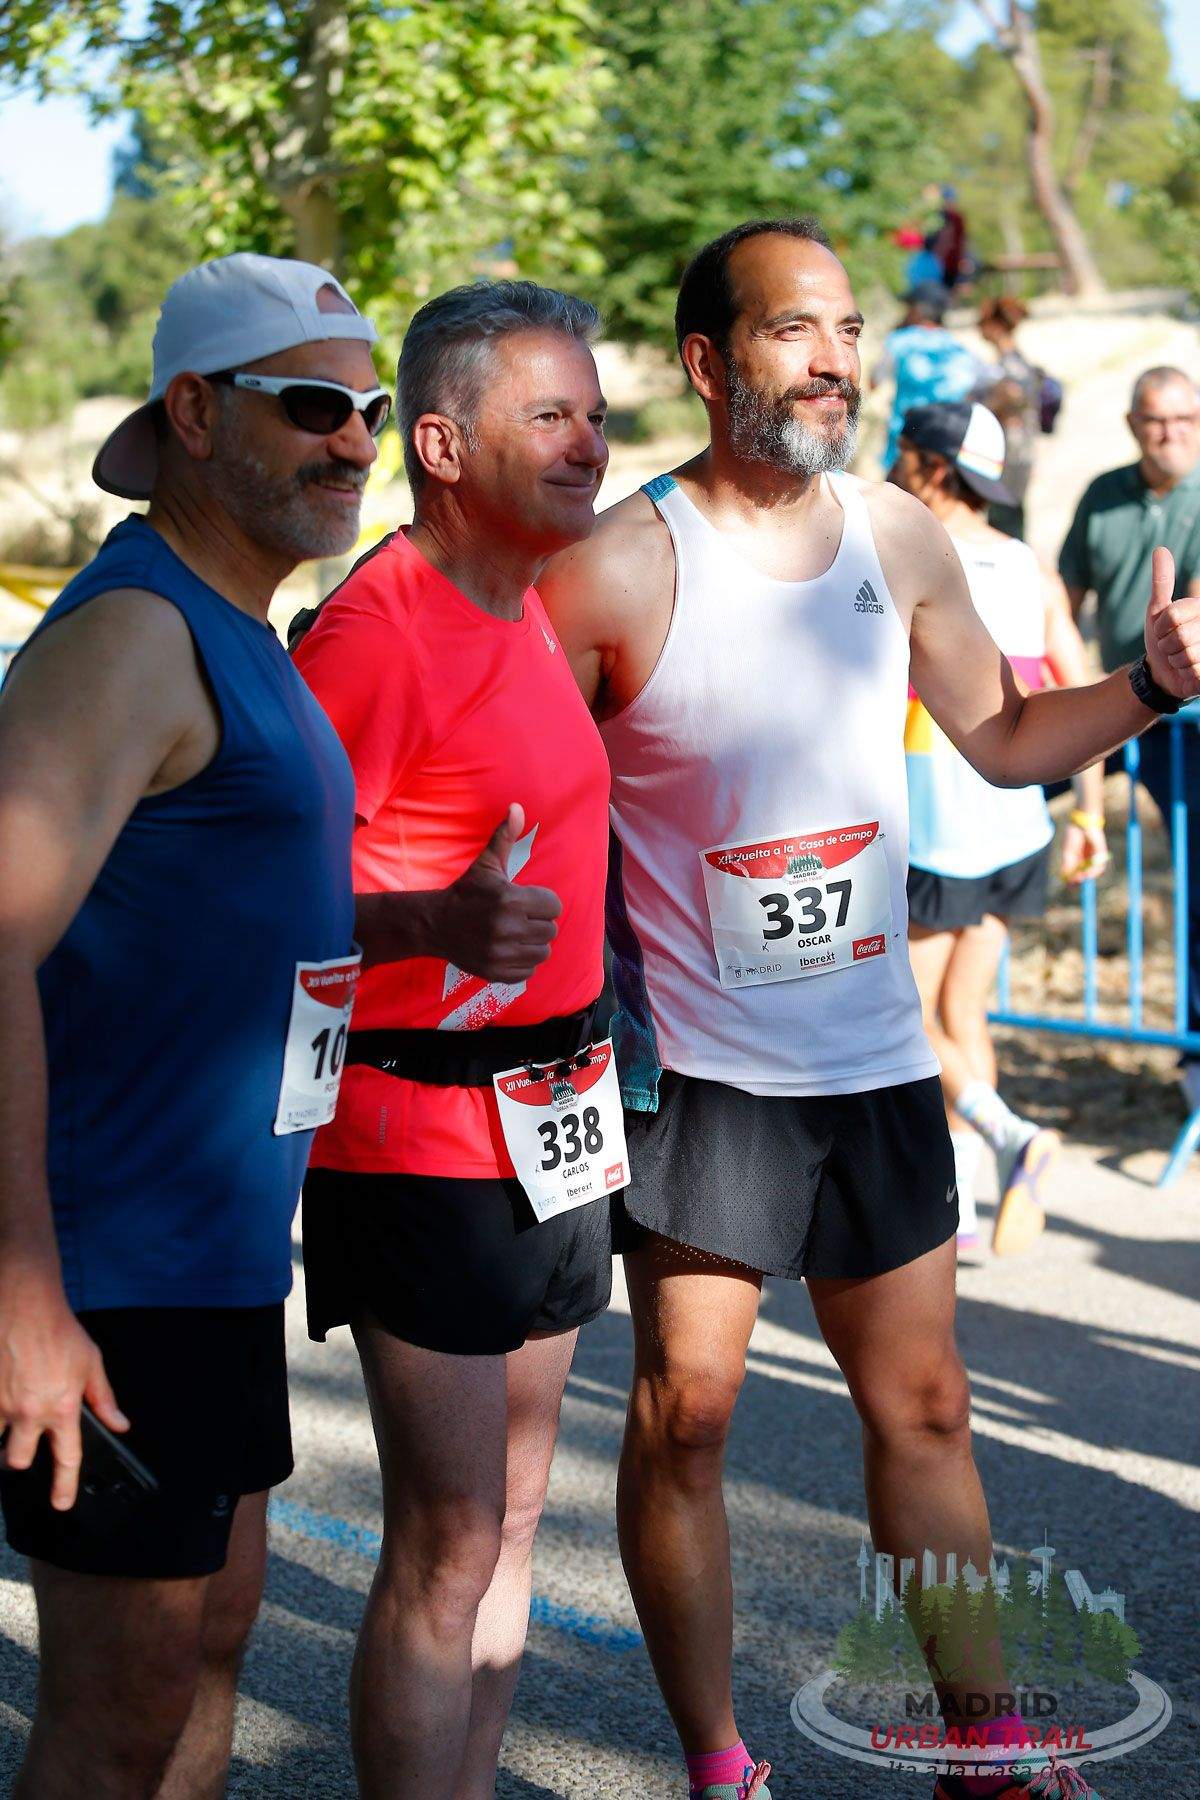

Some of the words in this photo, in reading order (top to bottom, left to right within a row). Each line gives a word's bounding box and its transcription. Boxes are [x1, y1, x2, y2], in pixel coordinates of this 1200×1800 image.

[853, 601, 885, 614] adidas
[733, 848, 771, 863] Vuelta
[773, 847, 781, 855] a
[783, 844, 794, 854] la
[799, 839, 825, 851] Casa
[826, 835, 838, 845] de
[839, 829, 873, 843] Campo
[793, 871, 818, 880] MADRID
[758, 879, 853, 941] 337
[797, 934, 832, 949] OSCAR
[799, 951, 836, 967] Iberext
[745, 963, 782, 976] MADRID
[311, 1022, 346, 1080] 10
[536, 1106, 604, 1171] 338
[562, 1161, 590, 1179] CARLOS
[566, 1181, 593, 1198] Iberext
